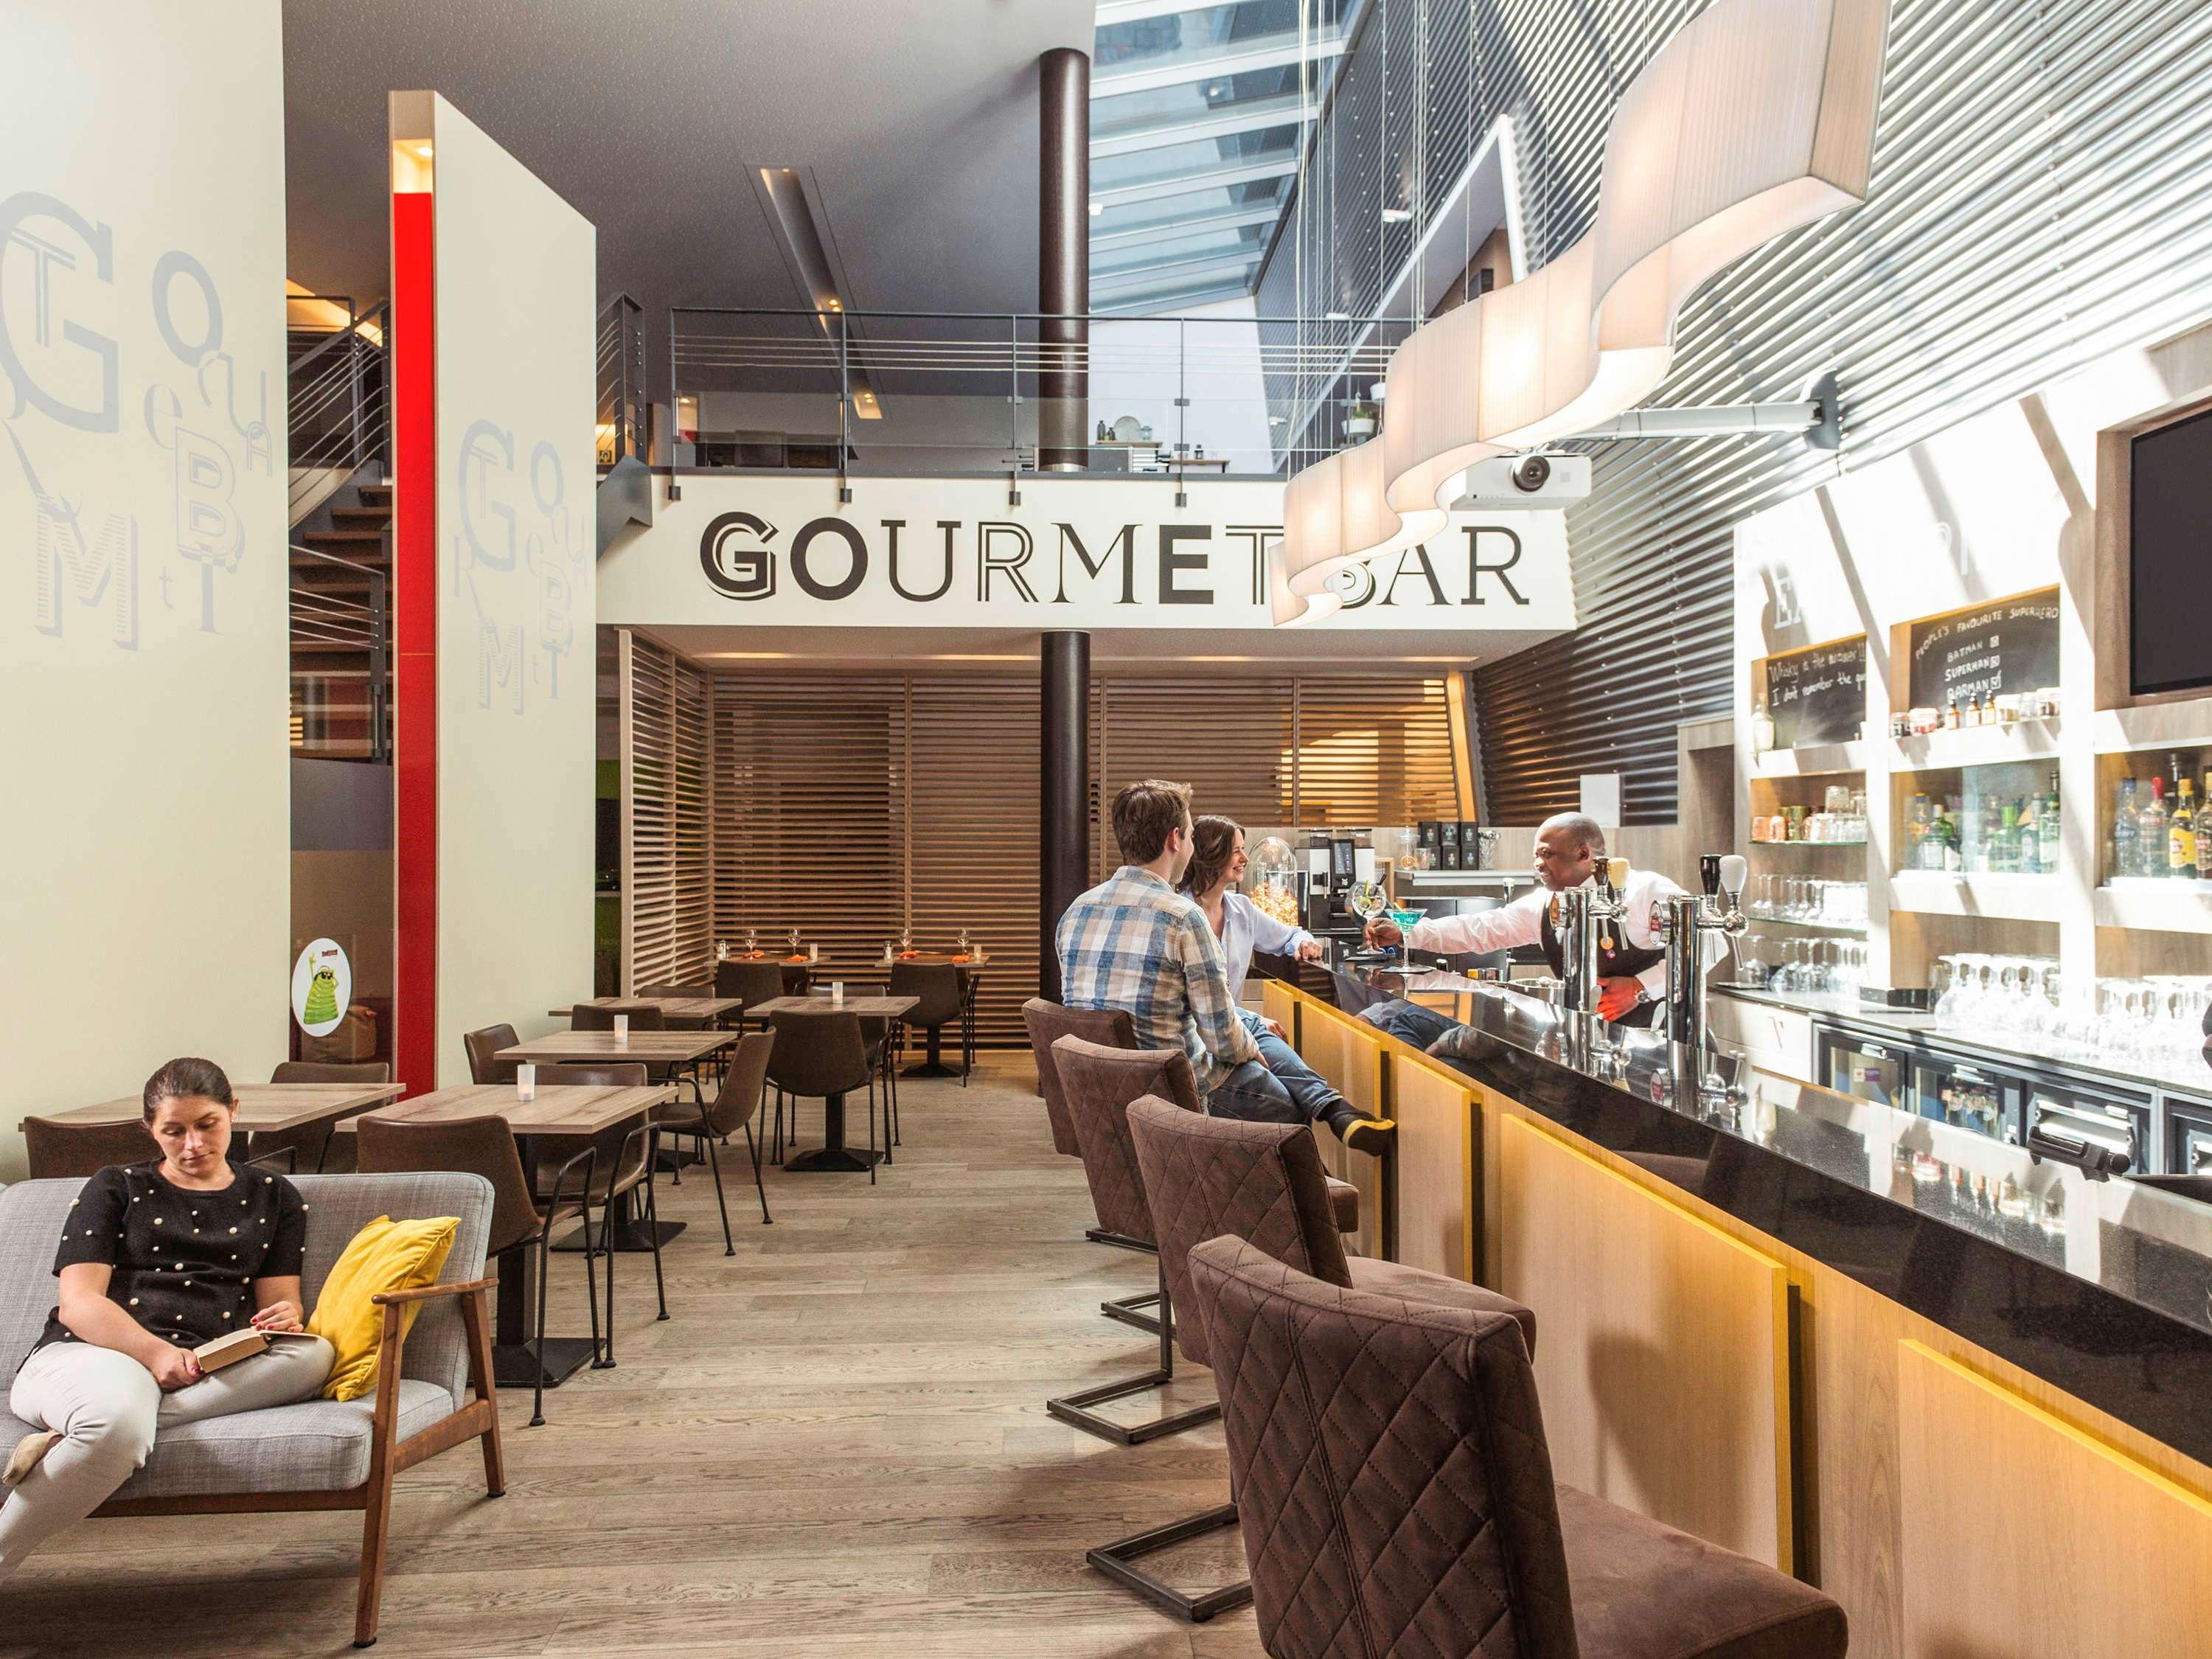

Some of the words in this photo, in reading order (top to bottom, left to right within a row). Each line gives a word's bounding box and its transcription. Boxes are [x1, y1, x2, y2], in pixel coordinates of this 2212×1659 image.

[699, 510, 1284, 605] GOURMET
[1956, 609, 2003, 633] FAVOURITE
[1947, 640, 1983, 663] BATMAN
[1944, 655, 1990, 682] SUPERMAN
[1771, 686, 1781, 707] I
[1946, 678, 1990, 700] BARMAN
